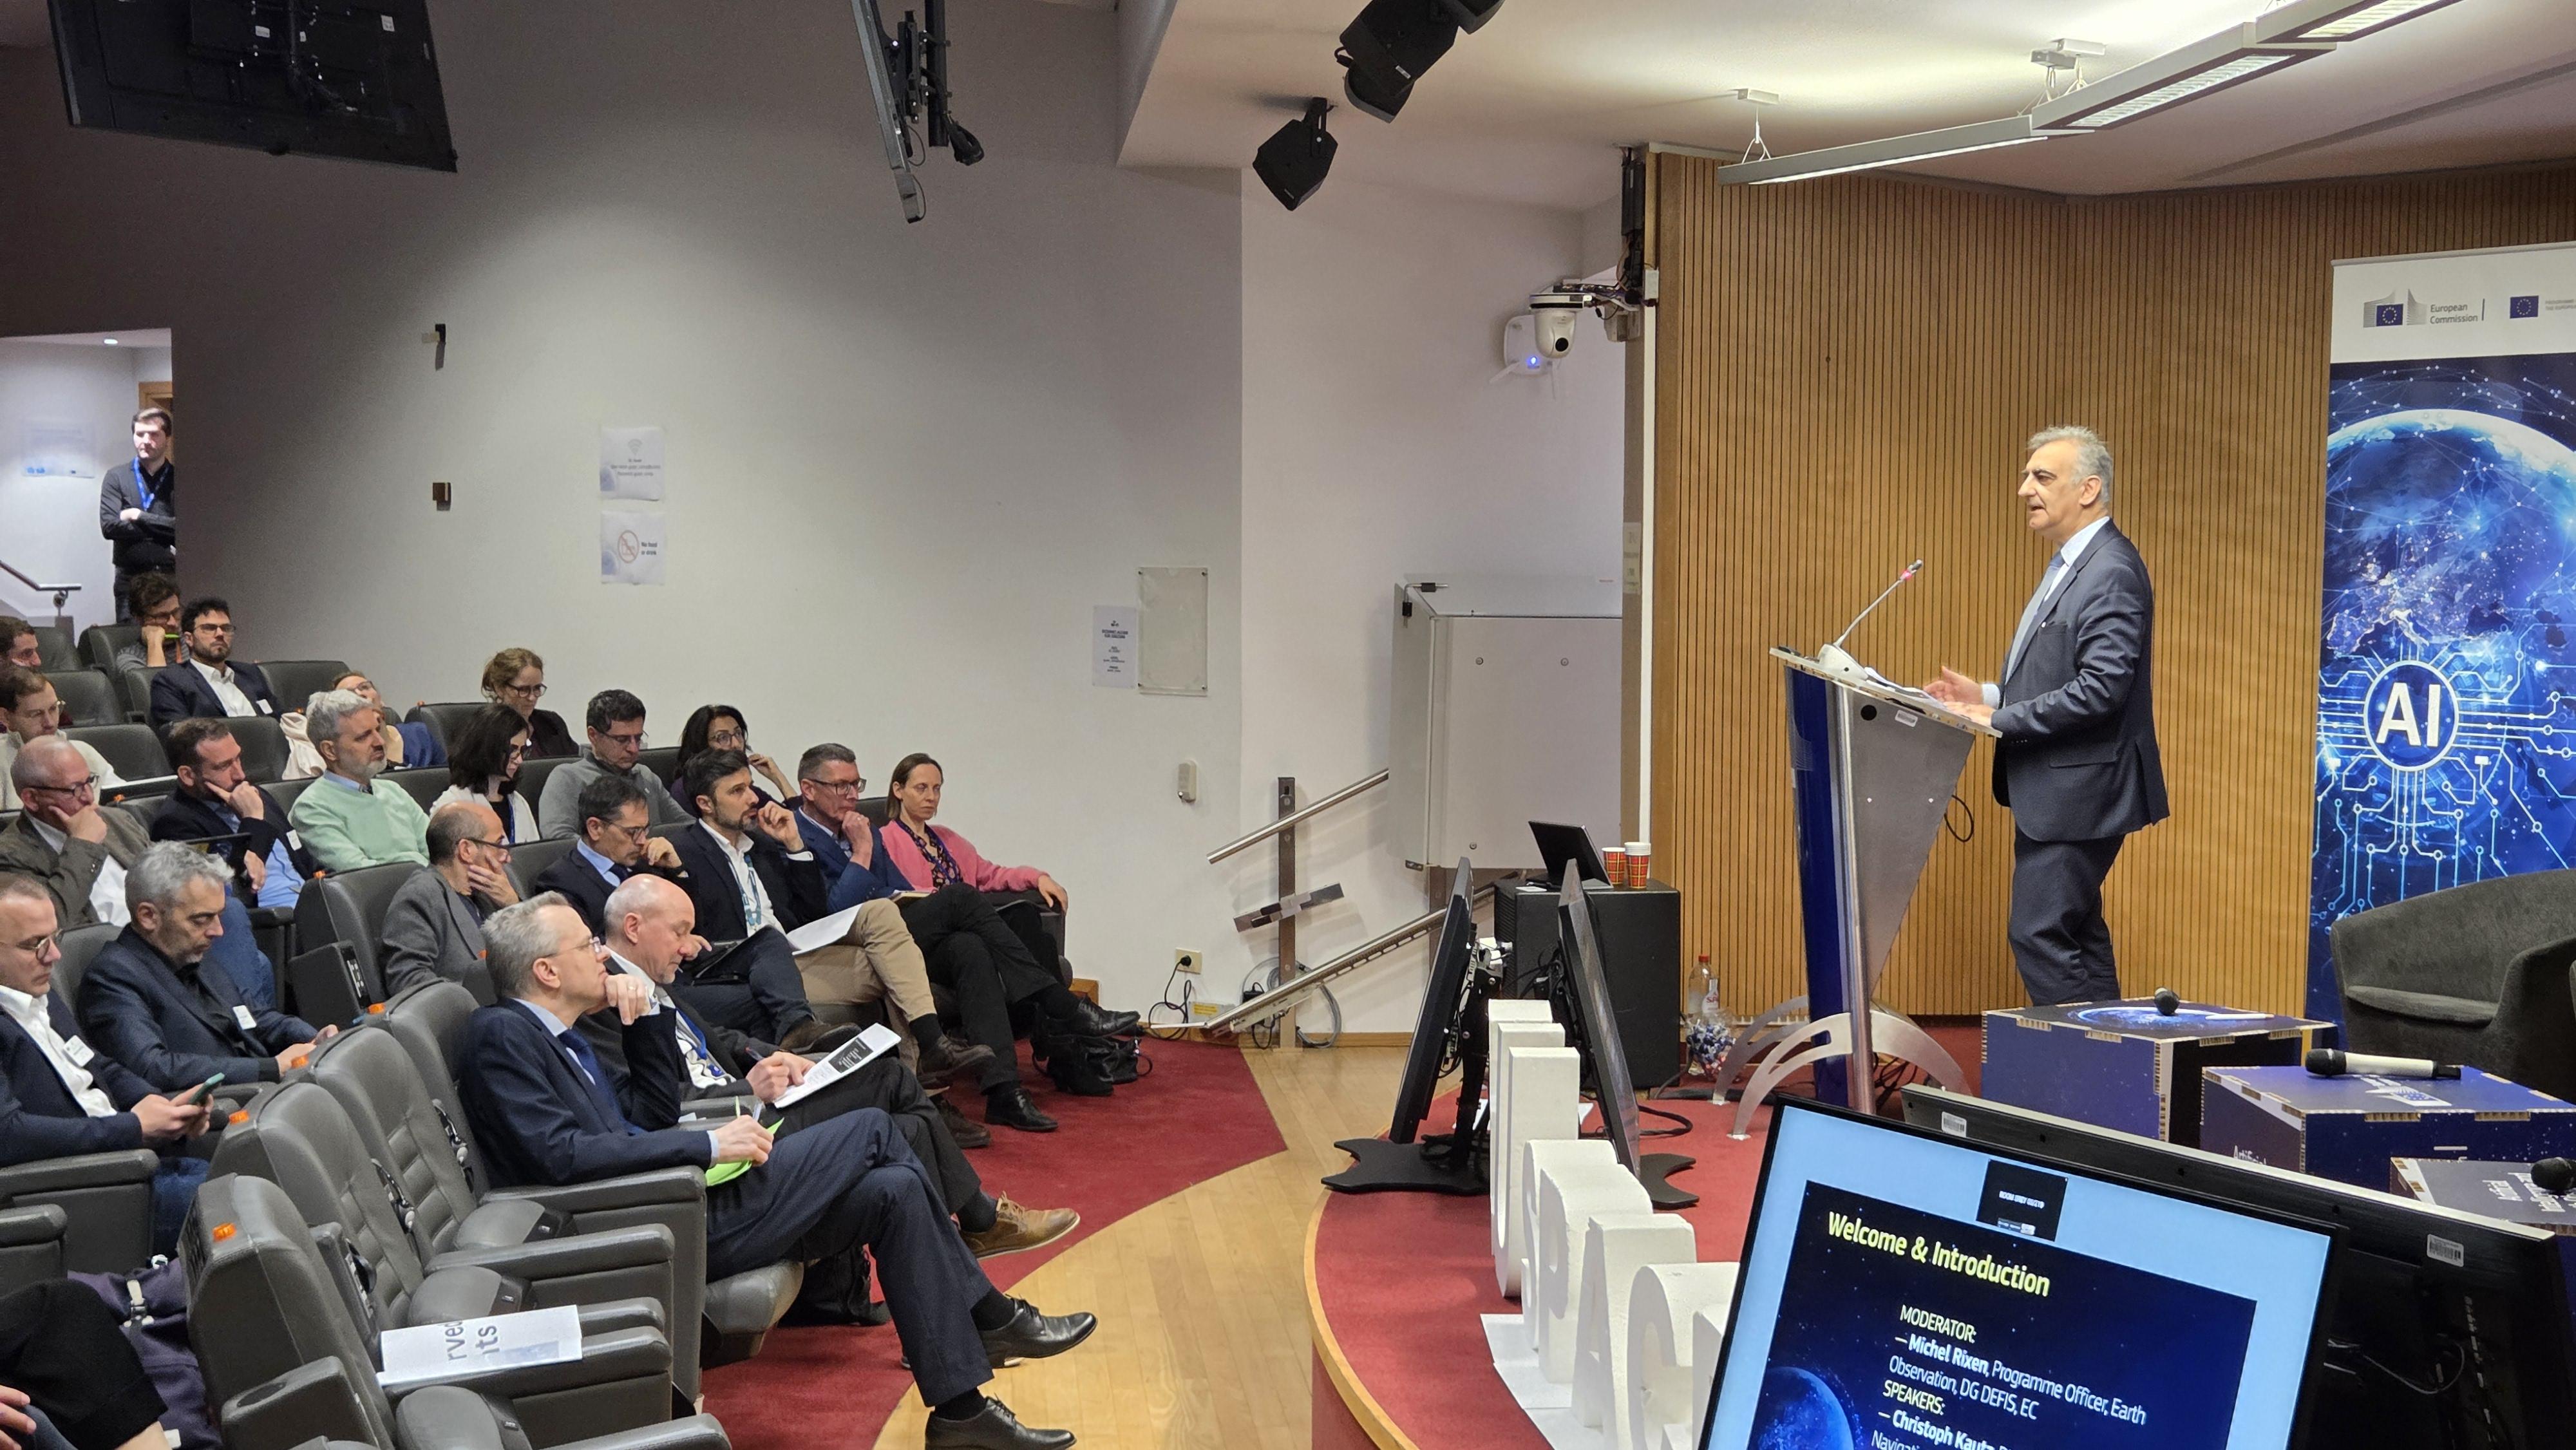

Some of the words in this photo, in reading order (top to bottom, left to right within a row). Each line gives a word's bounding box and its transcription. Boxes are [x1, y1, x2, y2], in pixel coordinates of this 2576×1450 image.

[2430, 303, 2468, 314] European
[2430, 314, 2478, 324] Commission
[2376, 682, 2441, 747] AI
[1829, 1210, 1908, 1256] Welcome
[1911, 1236, 1928, 1263] &
[1932, 1241, 2050, 1297] Introduction
[1900, 1304, 1976, 1344] MODERATOR:
[1882, 1380, 1946, 1415] SPEAKERS:
[1889, 1355, 1958, 1395] Observation,
[1960, 1377, 1980, 1400] DG
[1980, 1385, 2018, 1416] DEFIS,
[2020, 1398, 2040, 1420] EC
[1908, 1333, 1951, 1362] Michel
[1951, 1347, 1989, 1377] Rixen,
[1991, 1359, 2063, 1399] Programme
[2065, 1384, 2109, 1416] Officer,
[2110, 1397, 2147, 1426] Earth
[1892, 1409, 1954, 1446] Christoph
